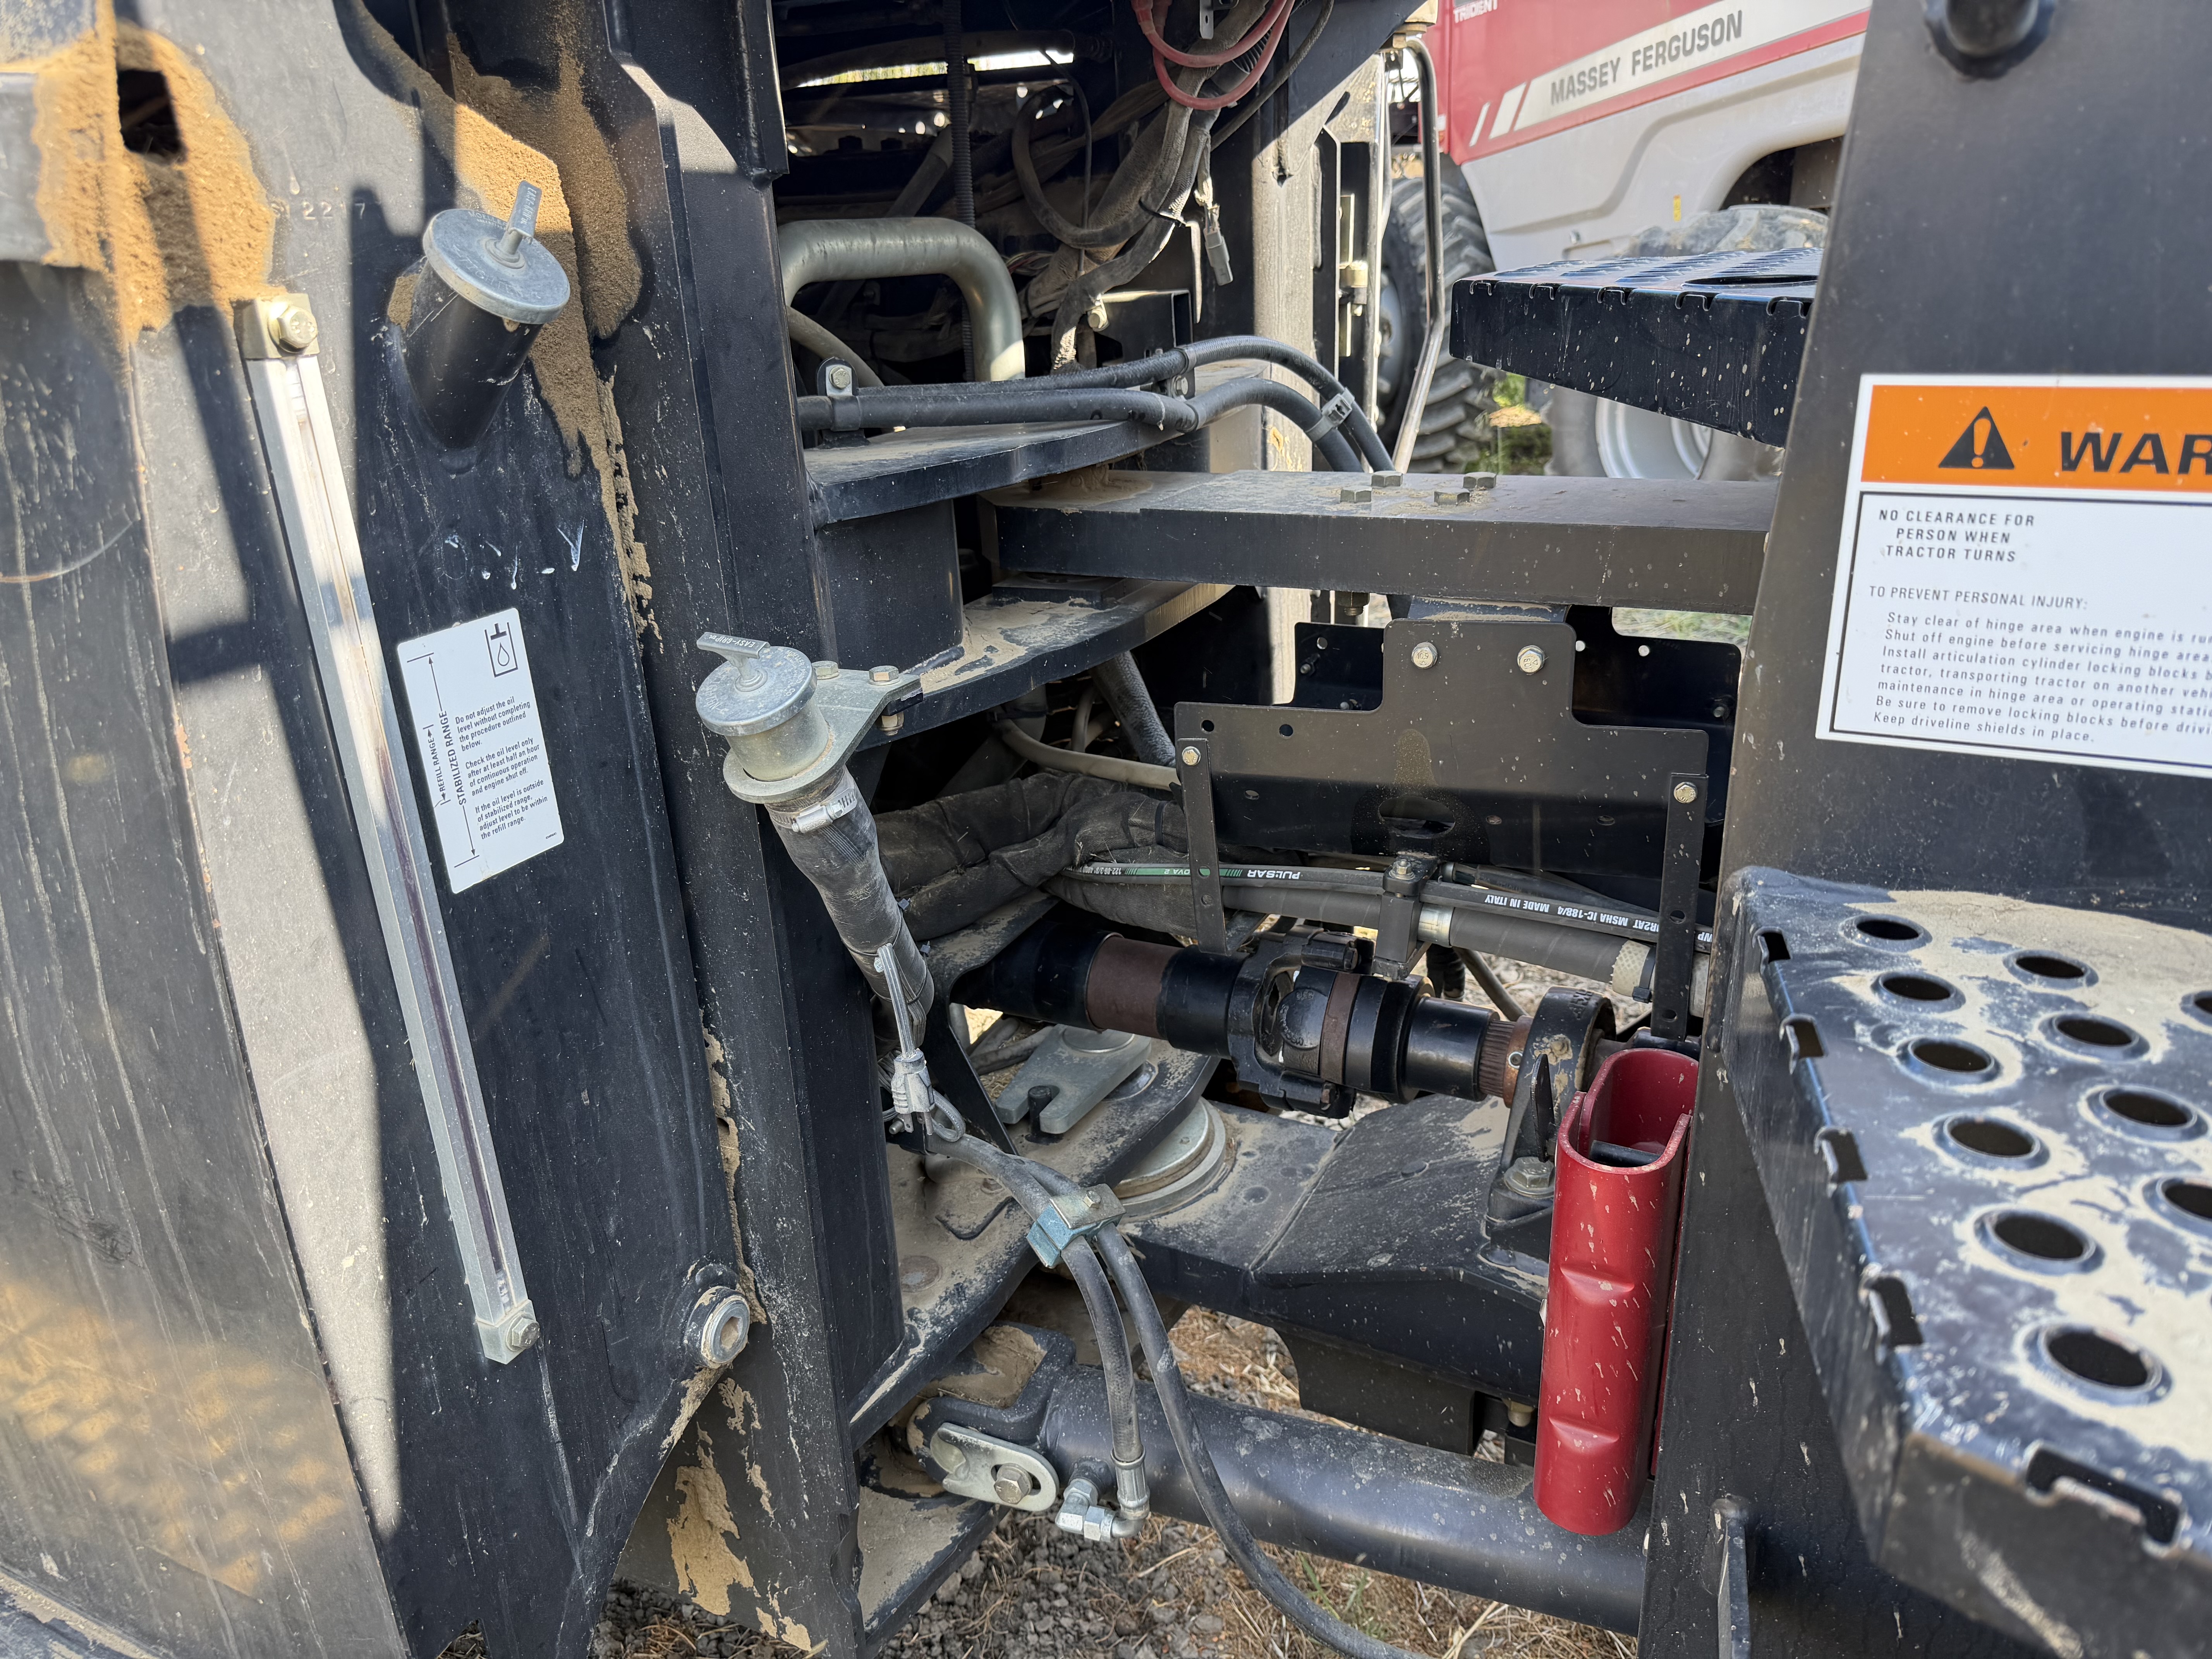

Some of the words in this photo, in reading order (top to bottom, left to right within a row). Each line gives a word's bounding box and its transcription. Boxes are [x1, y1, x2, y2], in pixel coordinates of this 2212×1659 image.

[1551, 57, 1621, 106] MASSEY
[1631, 10, 1743, 76] FERGUSON
[1879, 510, 1898, 521] NO
[1906, 510, 1997, 525] CLEARANCE
[2004, 514, 2034, 526] FOR
[1897, 528, 1957, 541] PERSON
[1965, 530, 2010, 544] WHEN
[1886, 545, 1956, 559] TRACTOR
[1964, 548, 2016, 562] TURNS
[1870, 586, 1885, 597] TO
[1891, 587, 1950, 601] PREVENT
[1955, 591, 2025, 606] PERSONAL
[2031, 595, 2088, 610] INJURY:
[1887, 611, 1918, 626] Stay
[1925, 615, 1959, 627] clear
[1965, 617, 1979, 628] of
[1986, 618, 2024, 633] hinge
[2031, 623, 2062, 634] area
[2069, 624, 2108, 638] when
[2115, 628, 2164, 642] engine
[2171, 630, 2184, 642] is
[1885, 629, 1915, 641] Shut
[1922, 632, 1942, 643] off
[1949, 635, 1994, 647] engine
[2001, 637, 2047, 651] before
[2053, 641, 2121, 658] servicing
[2129, 646, 2169, 661] hinge
[1883, 646, 1926, 659] Install
[1933, 652, 2015, 666] articulation
[2022, 658, 2080, 670] cylinder
[2087, 661, 2141, 677] locking
[2148, 666, 2197, 679] blocks
[1881, 664, 1932, 678] tractor,
[1940, 668, 2027, 686] transporting
[2035, 675, 2085, 688] tractor
[2093, 682, 2109, 690] on
[2117, 684, 2174, 696] another
[466, 712, 475, 721] not
[477, 704, 495, 716] adjust
[1878, 681, 1963, 696] maintenance
[1970, 687, 1982, 697] in
[1989, 688, 2026, 703] hinge
[2033, 694, 2063, 704] area
[2071, 697, 2084, 706] or
[2092, 699, 2163, 715] operating
[457, 722, 472, 733] level
[474, 713, 497, 727] without
[498, 702, 531, 718] completing
[459, 734, 469, 742] the
[471, 722, 501, 740] procedure
[503, 711, 526, 726] outlined
[1874, 711, 1905, 726] Keep
[1912, 715, 1970, 731] driveline
[1977, 721, 2025, 735] shields
[2033, 725, 2044, 737] in
[2051, 729, 2094, 742] place.
[1876, 696, 1891, 706] Be
[1898, 699, 1926, 709] sure
[1933, 702, 1945, 711] to
[1953, 704, 2001, 716] remove
[2008, 707, 2059, 723] locking
[2067, 712, 2113, 726] blocks
[2121, 717, 2169, 731] before
[439, 711, 453, 747] RANGE
[428, 737, 440, 766] RANGE
[461, 740, 482, 751] below.
[465, 756, 485, 769] Check
[506, 741, 520, 753] level
[522, 737, 533, 747] only
[468, 768, 481, 778] after
[490, 758, 505, 769] least
[506, 752, 517, 763] half
[527, 744, 539, 754] hour
[470, 779, 476, 787] of
[477, 766, 509, 784] continuous
[511, 755, 538, 770] operation
[435, 766, 446, 792] REFILL
[448, 749, 467, 805] STABILIZED
[472, 785, 483, 796] and
[484, 778, 504, 791] engine
[505, 771, 518, 781] shut
[519, 767, 528, 776] off.
[478, 814, 483, 822] of
[485, 801, 513, 819] stabilized
[514, 795, 532, 806] range,
[481, 803, 491, 811] the
[501, 790, 515, 802] level
[524, 779, 544, 793] outside
[480, 818, 498, 831] adjust
[499, 810, 513, 822] level
[530, 796, 548, 808] within
[481, 831, 491, 840] the
[492, 823, 506, 835] refill
[508, 816, 526, 828] range.
[1247, 869, 1300, 880] PULSAR
[1484, 895, 1508, 906] ITALY
[1510, 898, 1521, 908] IN
[1522, 900, 1550, 913] MADE
[1558, 906, 1597, 922] IC-188/4
[1600, 912, 1628, 926] MSHA
[1632, 919, 1659, 933] R2AT
